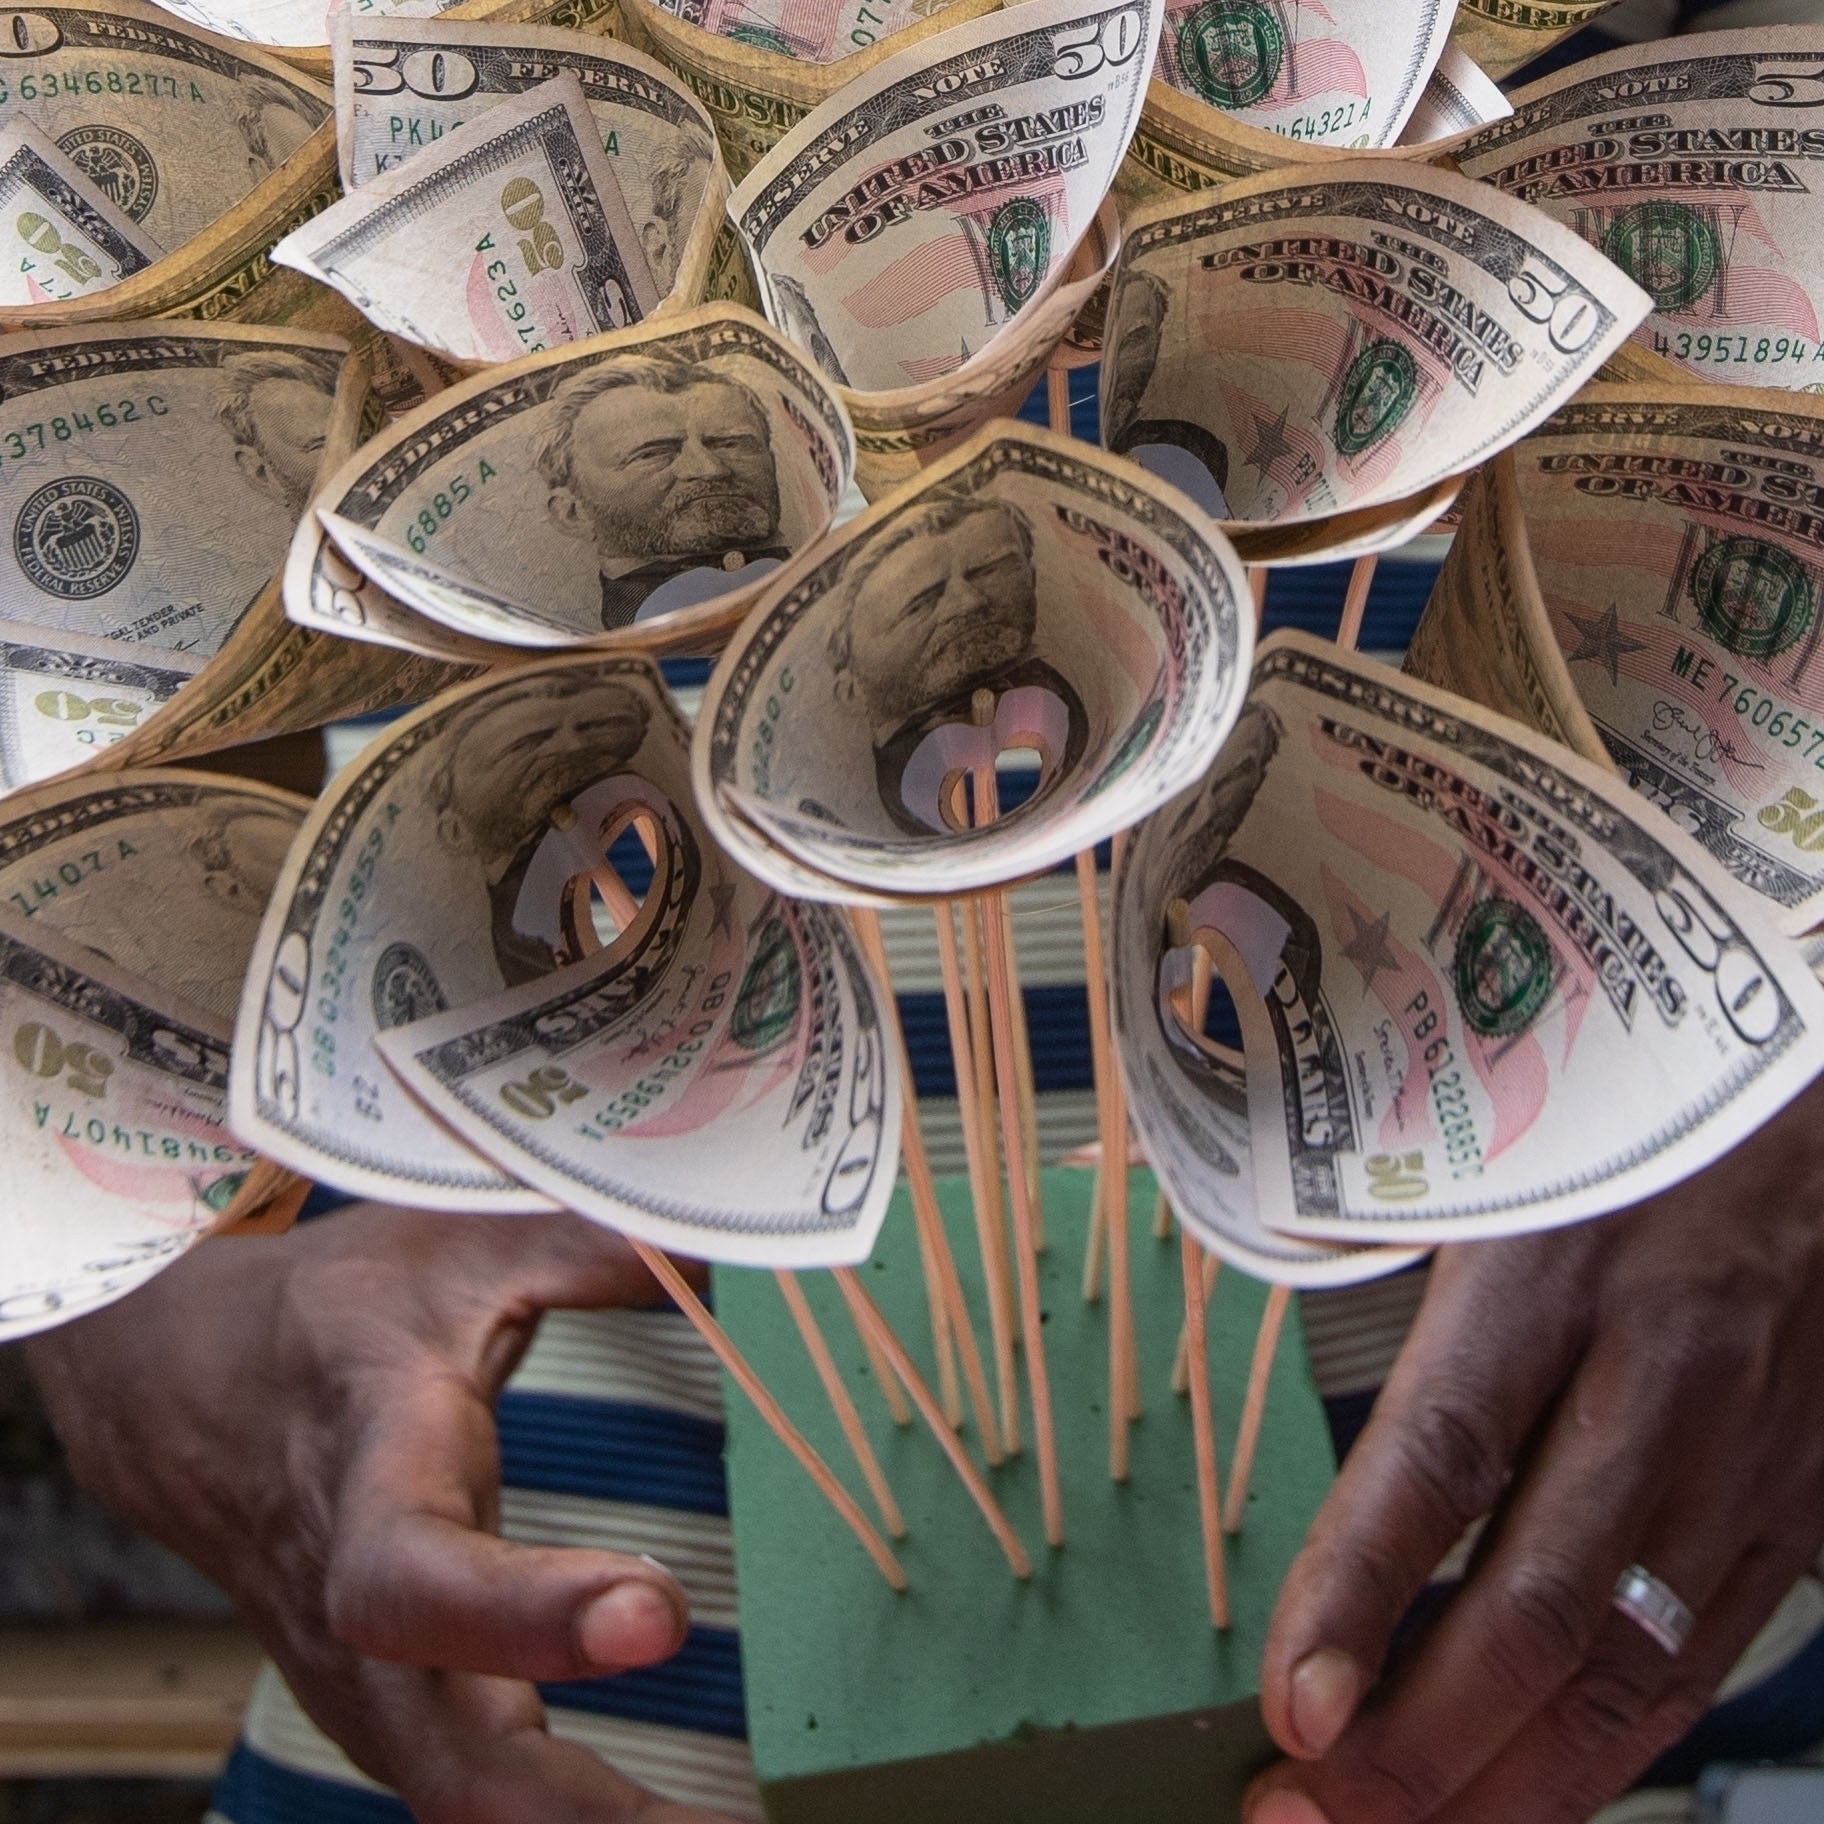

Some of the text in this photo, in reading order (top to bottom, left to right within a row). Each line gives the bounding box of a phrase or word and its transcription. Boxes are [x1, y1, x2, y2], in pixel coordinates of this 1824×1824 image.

[87, 21, 219, 66] FEDERAL
[20, 71, 177, 100] 63468277
[190, 82, 206, 104] A
[353, 48, 480, 102] 50
[1594, 75, 1691, 102] NOTE
[95, 129, 138, 158] STATES
[390, 116, 621, 156] PK A
[746, 119, 873, 241] RESERVE
[914, 58, 1006, 106] NOTE
[1052, 10, 1141, 80] 50
[925, 103, 1008, 139] THE
[1588, 113, 1673, 136] THE
[799, 94, 1108, 248] UNITED STATES
[846, 192, 916, 245] OF
[914, 136, 1090, 210] AMERICA
[1546, 160, 1812, 199] AMERICA
[16, 211, 102, 285] 50
[475, 232, 495, 252] A
[501, 177, 565, 277] 50
[1139, 194, 1327, 246] RESERVE
[1380, 196, 1476, 246] NOTE
[1507, 255, 1601, 355] 50
[1371, 230, 1448, 278] THE
[1199, 237, 1524, 375] UNITED STATES
[1239, 263, 1321, 287] OF
[1320, 267, 1485, 397] AMERICA
[28, 341, 199, 377] FEDERAL
[1653, 331, 1806, 364] 43951894
[147, 394, 169, 416] C
[369, 387, 528, 500] FEDERAL
[1720, 449, 1816, 481] THE
[1537, 453, 1752, 488] UNITED
[1574, 475, 1660, 501] OF
[20, 482, 107, 533] UNITED STATES
[407, 459, 498, 555] 6885 A
[21, 503, 135, 594] FEDERAL RESERVE SYSTEM
[133, 604, 177, 630] TENDER
[137, 603, 205, 642] AND PRIVATE
[1670, 646, 1715, 692] ME
[34, 690, 144, 726] 50
[10, 850, 104, 918] 1407
[117, 839, 138, 861] A
[1441, 805, 1639, 1034] AMERICA
[1533, 833, 1688, 1027] STATES
[1656, 874, 1780, 1047] 50
[257, 932, 311, 1122] 50
[1405, 990, 1438, 1040] PB
[14, 1022, 115, 1099] 50
[33, 1100, 51, 1127] A
[1365, 1149, 1430, 1201] 50
